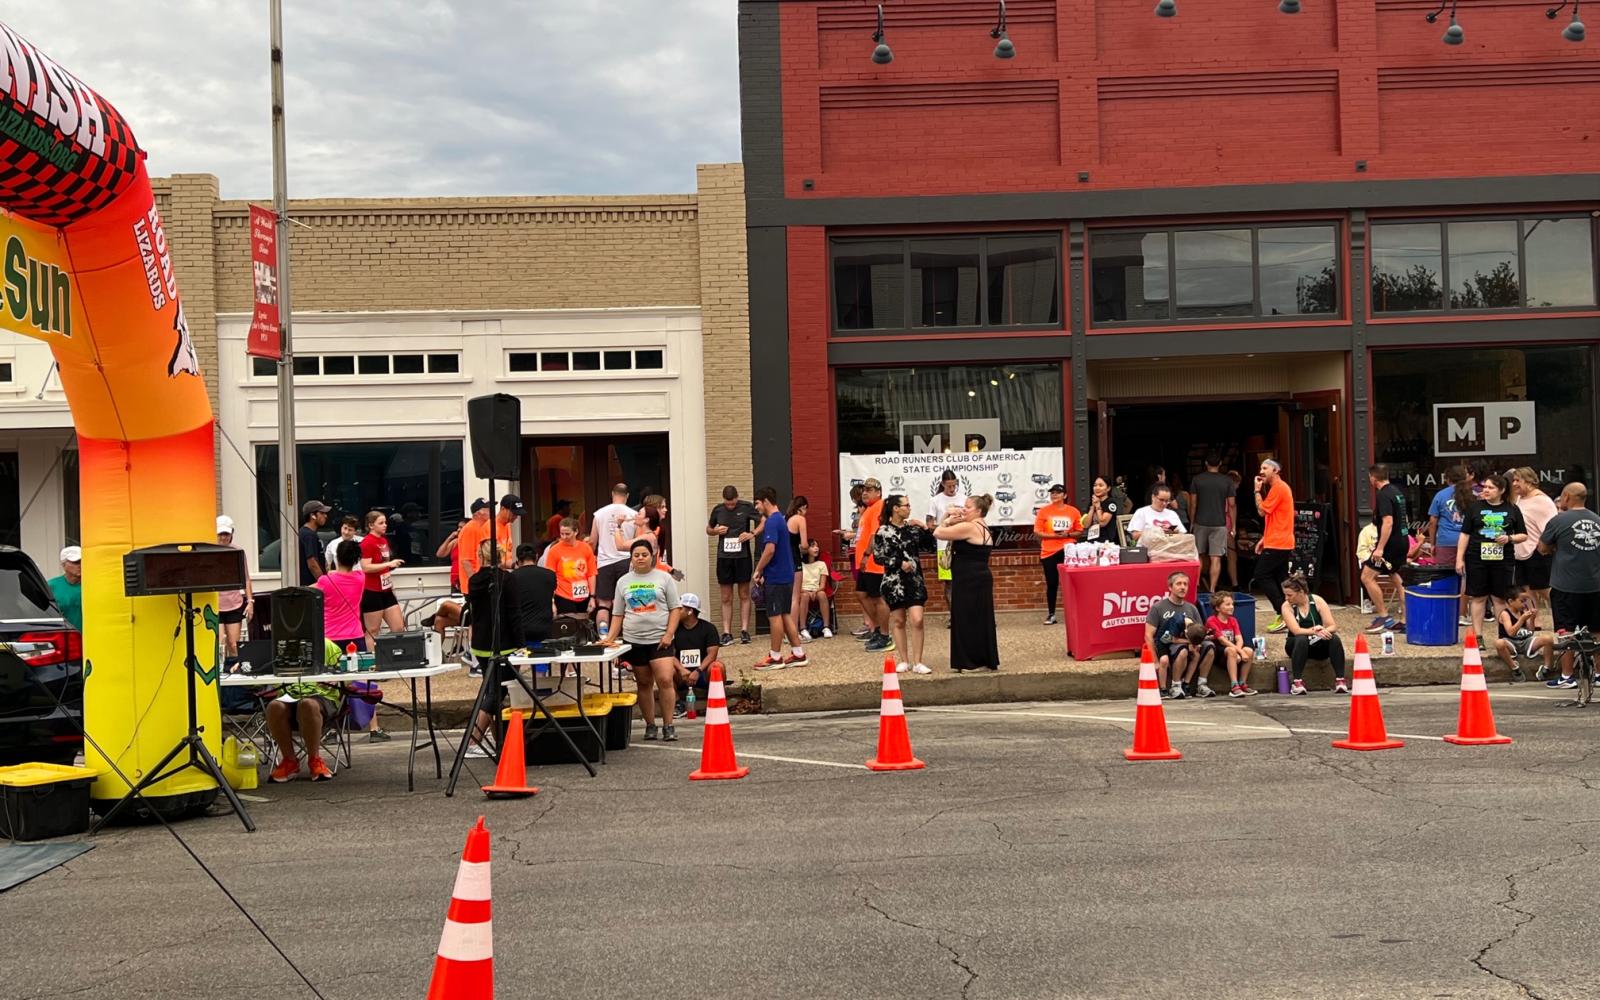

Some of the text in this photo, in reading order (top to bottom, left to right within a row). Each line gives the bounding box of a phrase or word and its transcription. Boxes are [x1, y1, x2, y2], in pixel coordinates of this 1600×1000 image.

[148, 204, 177, 300] ROAD
[133, 218, 165, 311] LIZARDS
[5, 236, 71, 338] Sun
[875, 453, 1025, 465] ROAD RUNNERS CLUB OF AMERICA
[903, 464, 999, 474] STATE CHAMPIONSHIP
[1053, 519, 1069, 528] 2291
[1481, 546, 1503, 555] 2562
[1105, 618, 1126, 627] AUTO
[681, 654, 699, 664] 2307
